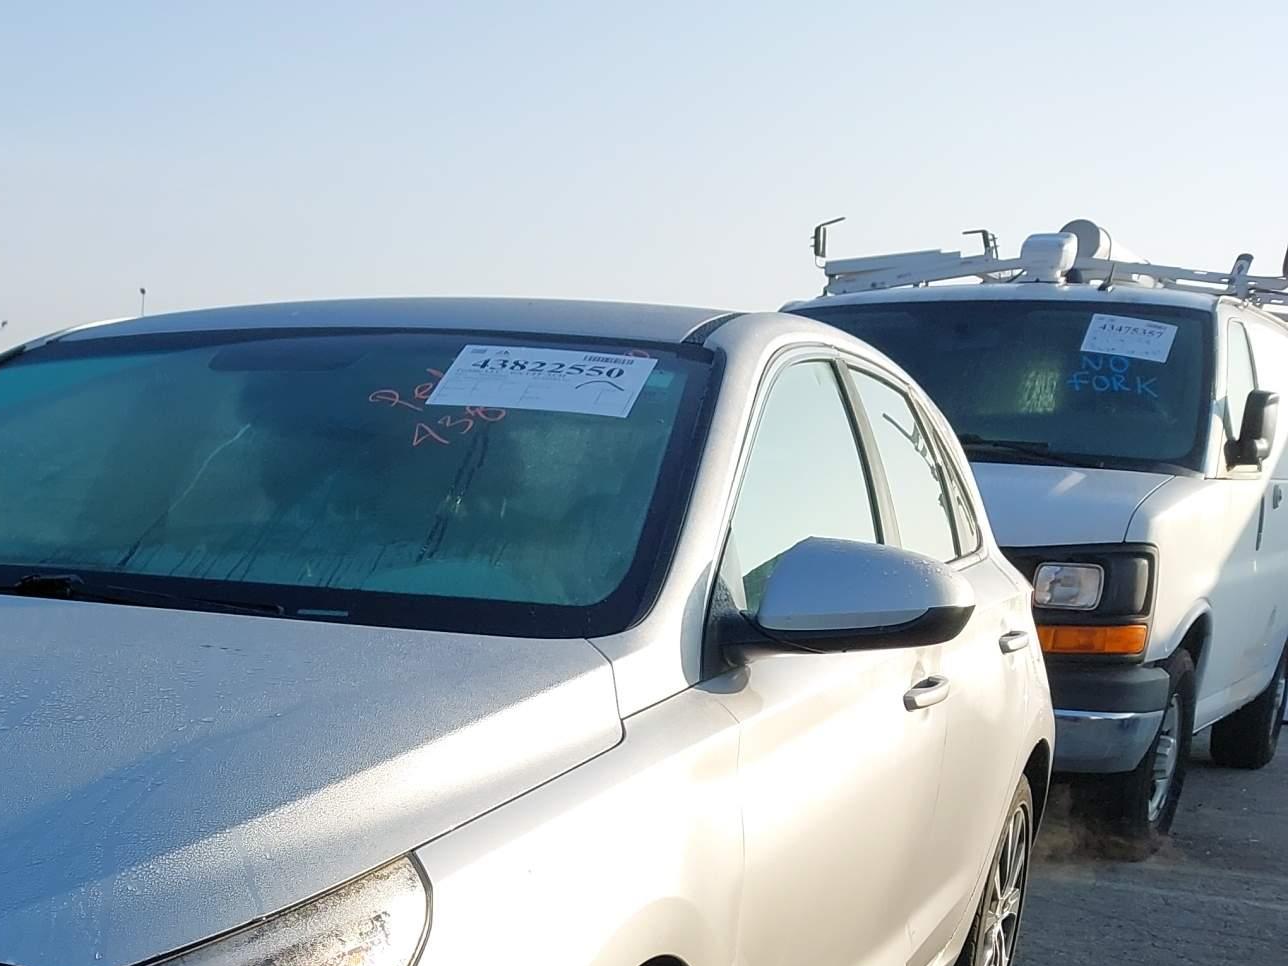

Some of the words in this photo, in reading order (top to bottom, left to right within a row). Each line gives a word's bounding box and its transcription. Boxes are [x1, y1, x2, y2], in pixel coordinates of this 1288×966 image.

[471, 357, 626, 379] 43822550
[1080, 355, 1130, 374] NO
[1067, 371, 1159, 398] FORK
